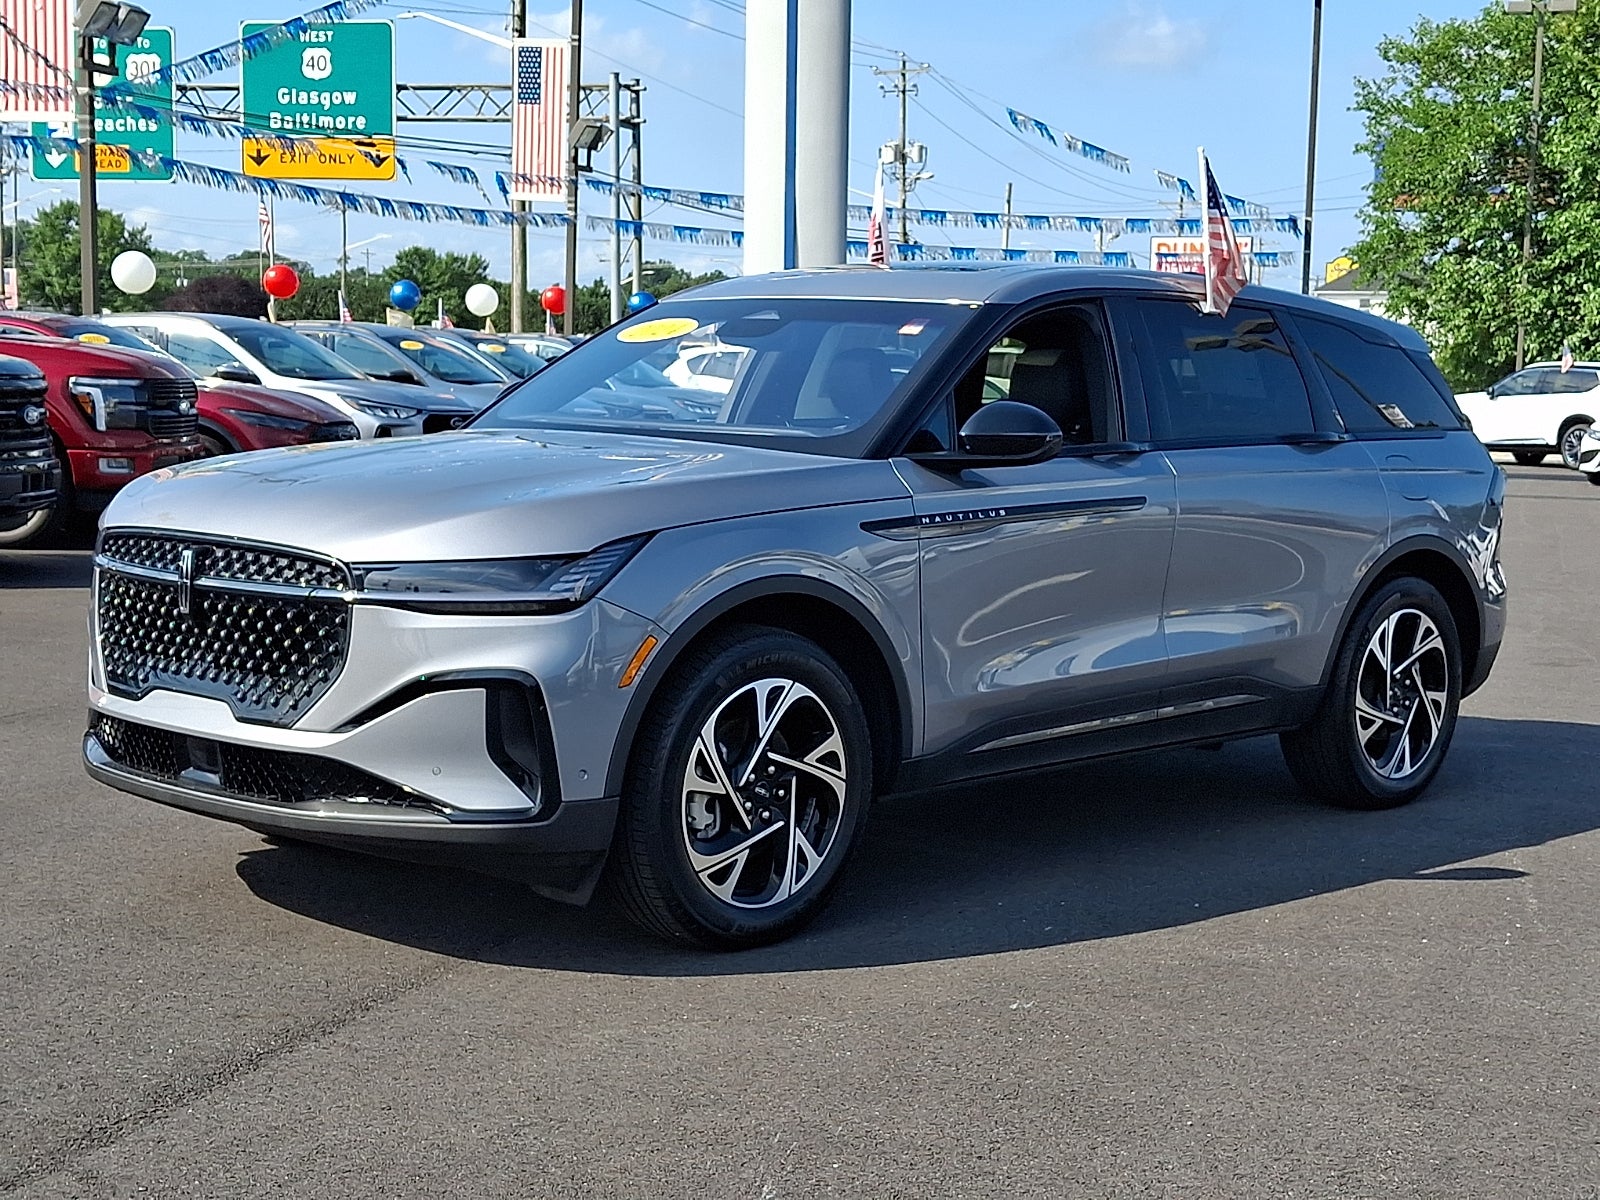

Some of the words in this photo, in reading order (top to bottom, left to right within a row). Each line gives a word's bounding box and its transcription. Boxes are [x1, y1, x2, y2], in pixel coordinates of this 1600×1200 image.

[299, 30, 334, 43] WEST
[305, 55, 328, 72] 40
[277, 87, 357, 111] Glasgow
[93, 115, 158, 132] eaches
[269, 111, 367, 130] Baltimore
[279, 152, 312, 164] EXIT
[318, 152, 356, 165] ONLY
[921, 509, 1006, 525] NAUTILUS
